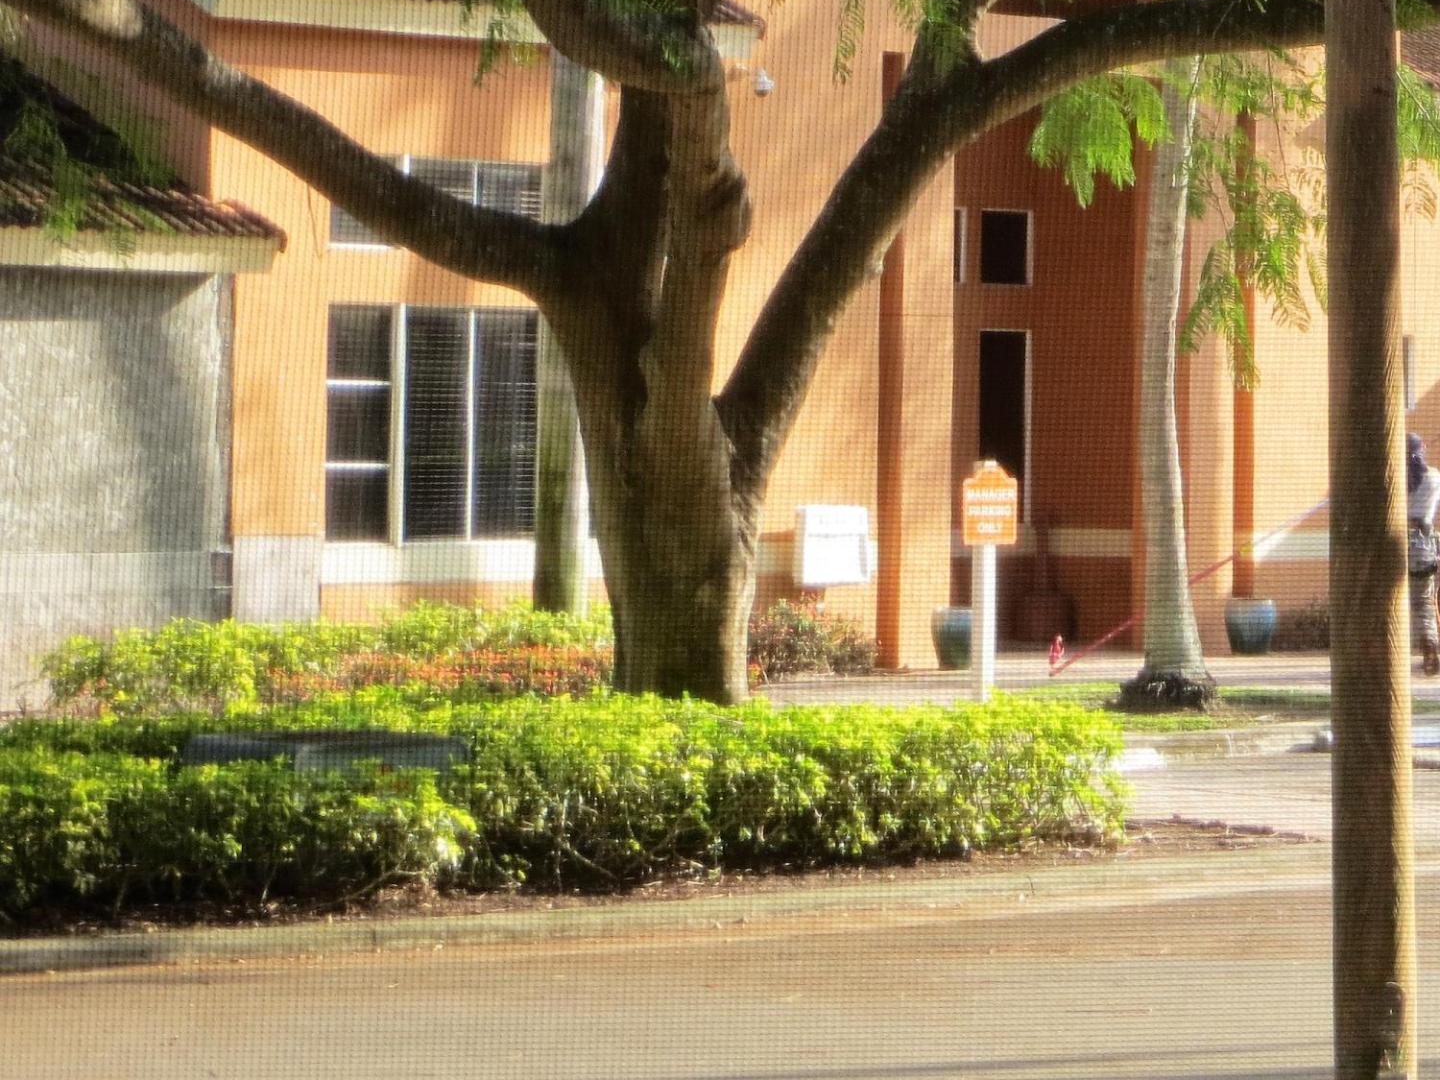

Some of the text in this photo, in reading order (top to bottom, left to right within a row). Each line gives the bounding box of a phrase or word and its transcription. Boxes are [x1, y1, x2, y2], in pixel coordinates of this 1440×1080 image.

[967, 487, 1015, 499] MANAGER
[968, 505, 1011, 516] PARKING
[977, 522, 1003, 533] ONLY
